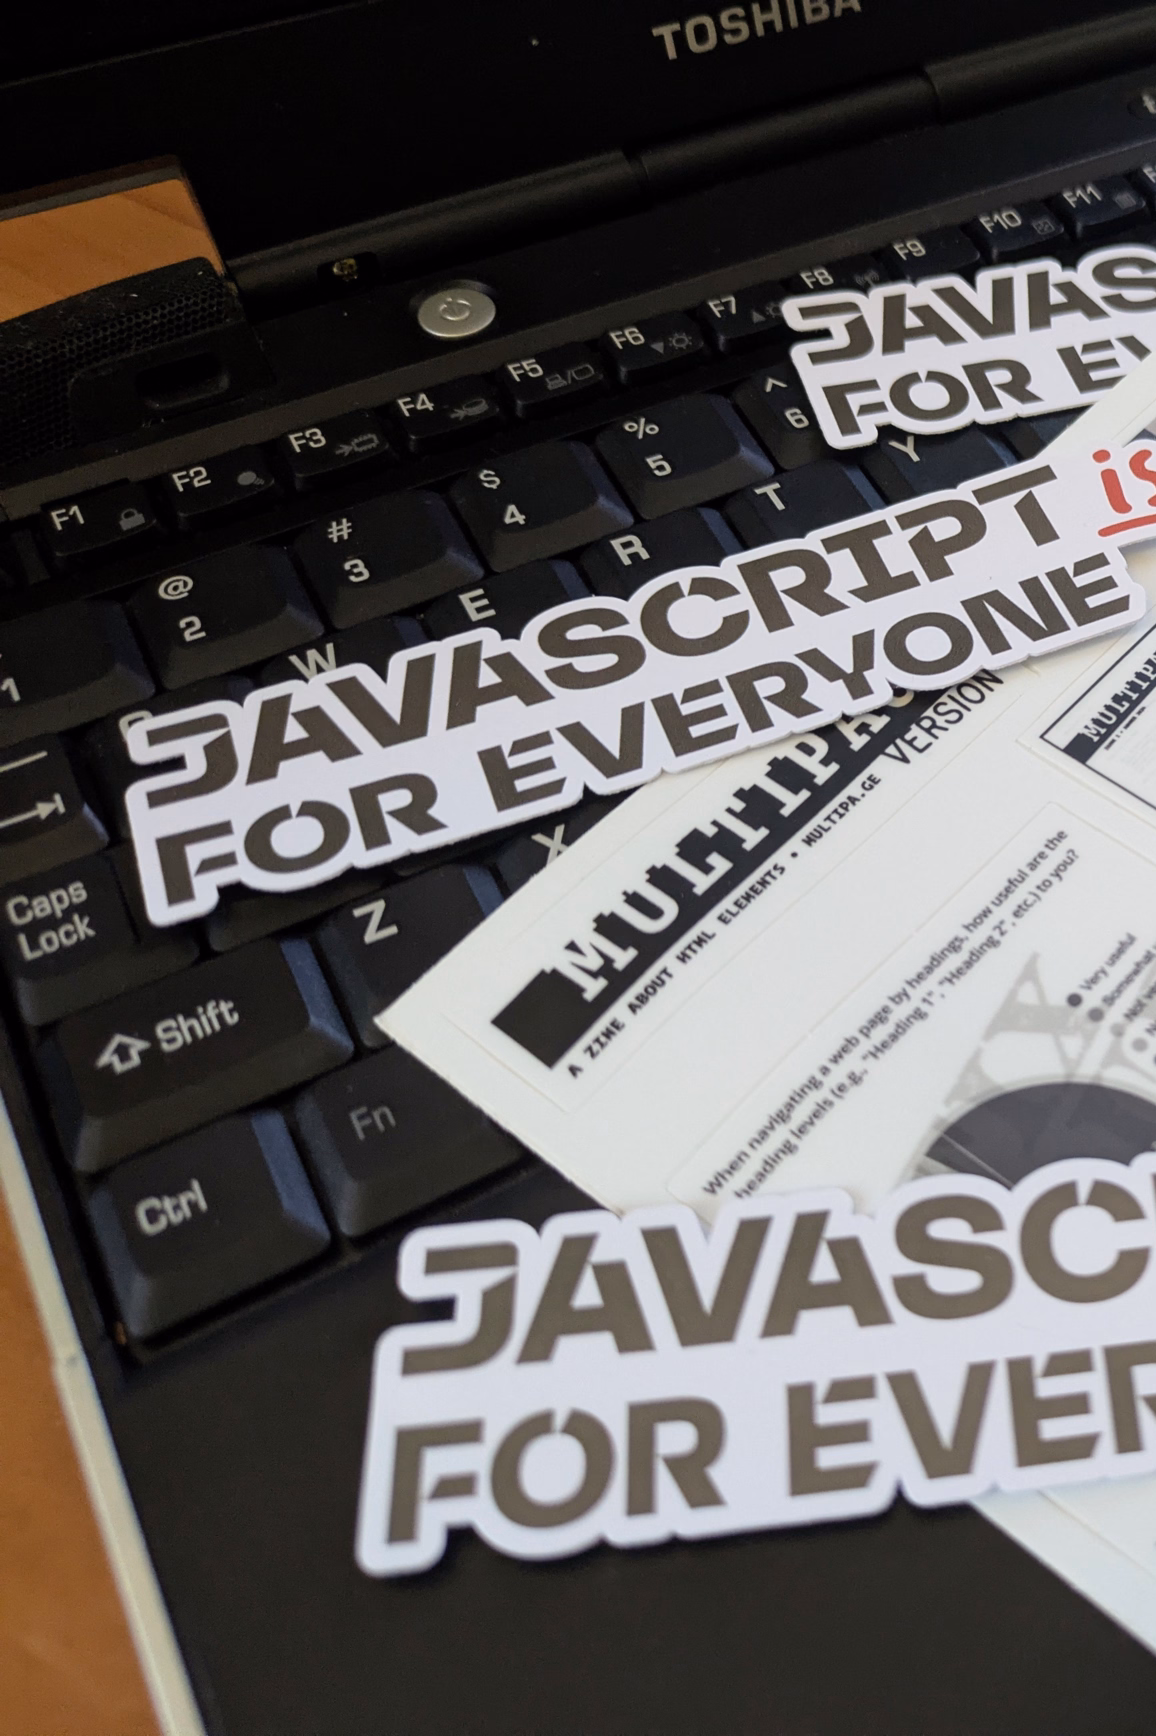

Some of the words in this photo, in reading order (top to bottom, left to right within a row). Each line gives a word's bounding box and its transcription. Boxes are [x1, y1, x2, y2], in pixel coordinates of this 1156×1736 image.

[1062, 182, 1102, 207] F11
[979, 208, 1021, 234] F10
[893, 239, 926, 261] F9
[800, 268, 834, 289] F8
[708, 296, 737, 320] F7
[609, 326, 645, 350] F6
[506, 359, 543, 383] F5
[397, 392, 434, 418] F4
[822, 358, 1045, 437] FOR
[785, 409, 810, 429] 6
[288, 428, 326, 453] F3
[888, 435, 921, 463] Y
[172, 466, 211, 492] F2
[646, 454, 672, 478] 5
[754, 482, 788, 511] T
[51, 505, 85, 531] F1
[328, 518, 353, 543] #
[503, 504, 527, 528] 4
[611, 535, 650, 565] R
[344, 558, 370, 583] 3
[158, 575, 194, 601] @
[459, 589, 496, 620] E
[146, 464, 1061, 810] JAVASCRIPT
[179, 616, 206, 642] 2
[288, 643, 337, 680] W
[155, 772, 448, 908] FOR
[477, 552, 1131, 813] EVERYONE
[880, 668, 1004, 766] VERSION
[553, 688, 916, 1003] MULTIPA
[5, 880, 88, 926] Caps
[353, 899, 398, 944] Z
[567, 1063, 583, 1079] A
[583, 1016, 625, 1060] ZINE
[627, 966, 674, 1016] ABOUT
[675, 929, 716, 966] HTML
[717, 862, 786, 926] ELEMENTS
[801, 773, 882, 848] MULTIPA.GE
[17, 912, 96, 961] Lock
[1079, 965, 1109, 992] Very
[1105, 932, 1137, 969] useful
[1102, 948, 1156, 1008] Somewhat
[702, 1149, 750, 1196] When
[747, 1074, 825, 1152] navigating
[818, 1064, 831, 1078] a
[828, 1034, 861, 1066] web
[858, 1003, 894, 1040] page
[888, 984, 912, 1008] by
[905, 934, 969, 990] headings,
[961, 905, 994, 935] how
[990, 868, 1030, 908] useful
[1026, 850, 1049, 873] are
[1044, 828, 1068, 853] the
[734, 1138, 799, 1199] heading
[789, 1097, 835, 1141] levels
[1036, 877, 1053, 894] to
[1050, 848, 1080, 882] you?
[1123, 995, 1147, 1023] Not
[155, 998, 240, 1054] Shift
[349, 1105, 396, 1140] Fn
[134, 1177, 208, 1237] Ctrl
[386, 1396, 728, 1545] FOR
